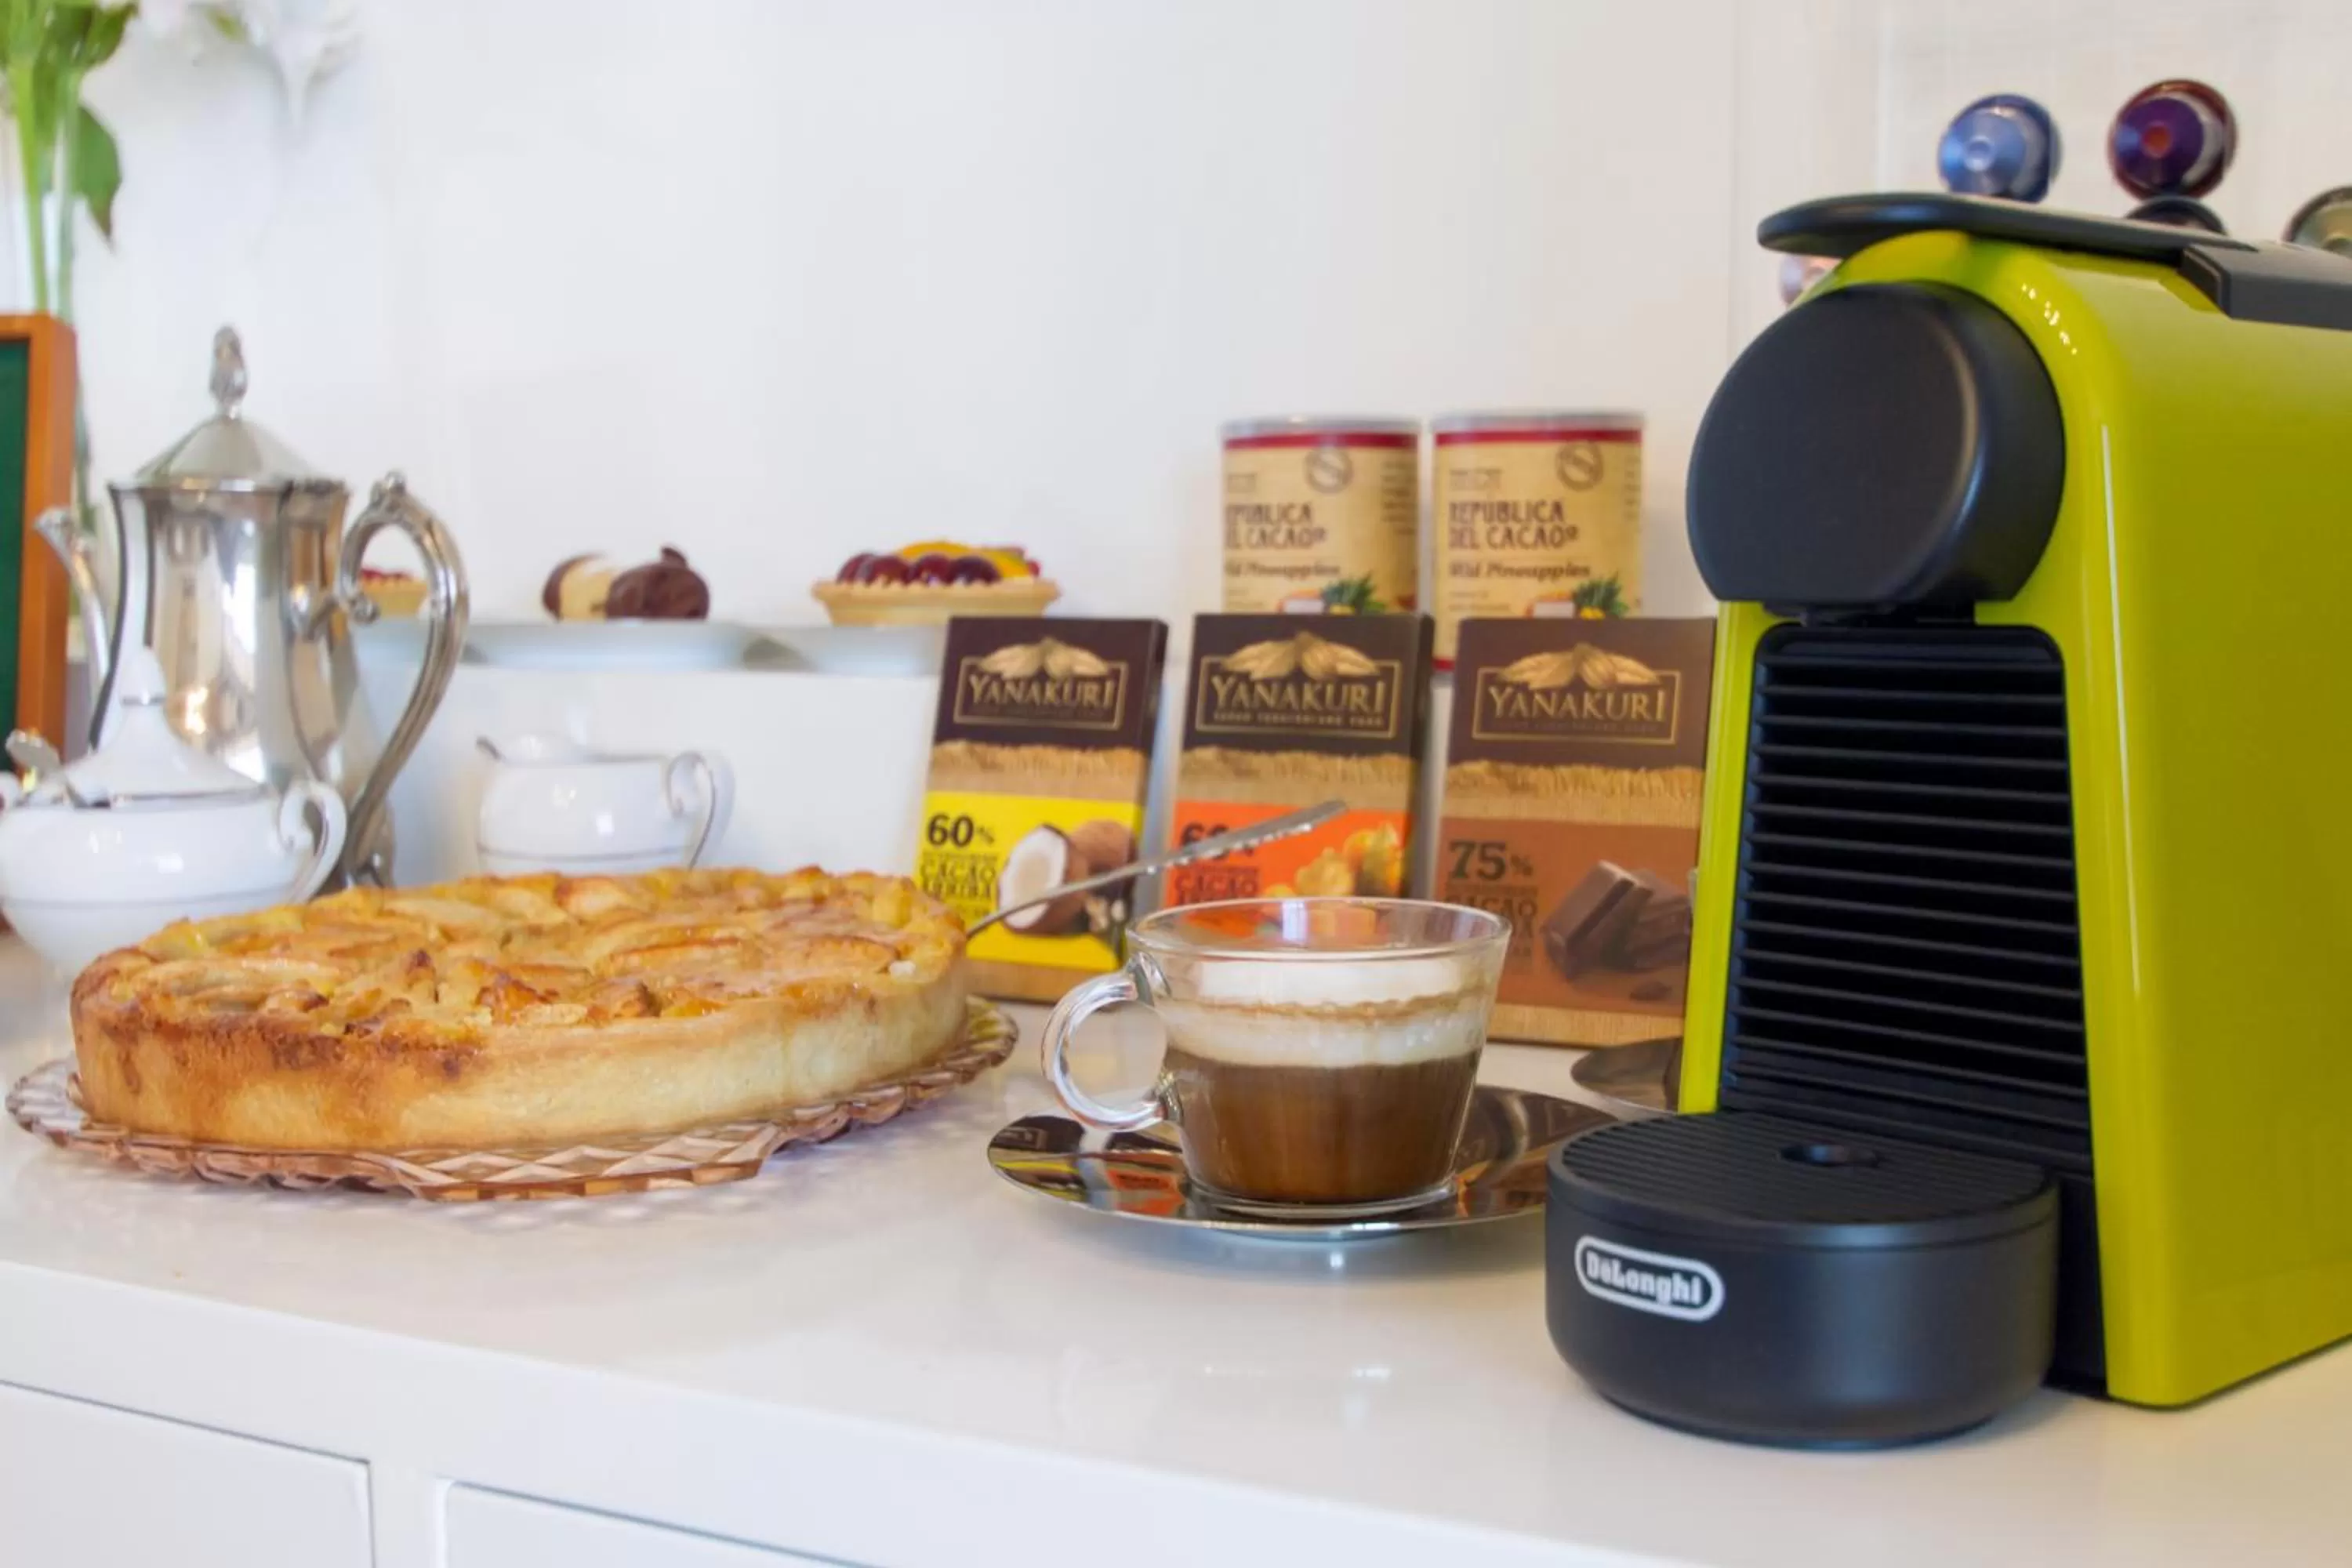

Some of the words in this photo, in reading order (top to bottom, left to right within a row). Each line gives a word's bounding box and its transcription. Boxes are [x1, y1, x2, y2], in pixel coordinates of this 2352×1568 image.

[969, 673, 1115, 709] YANAKURI
[1210, 675, 1386, 713] YANAKURI
[1487, 686, 1666, 722] YANAKURI
